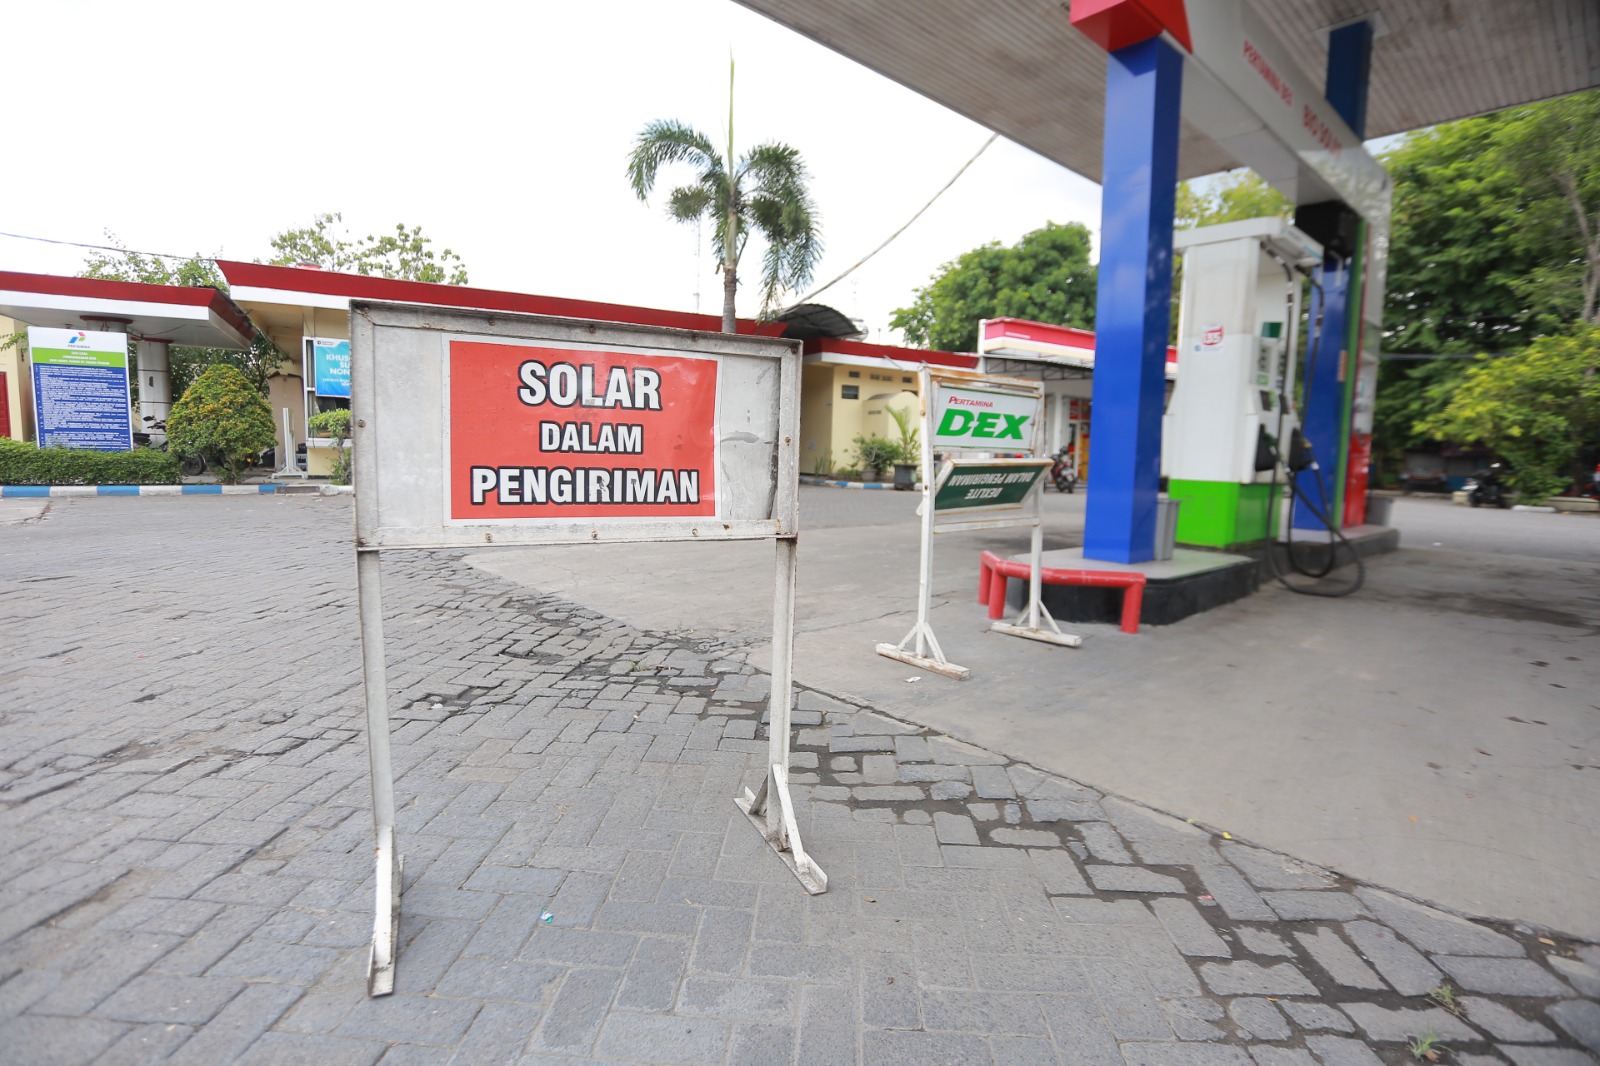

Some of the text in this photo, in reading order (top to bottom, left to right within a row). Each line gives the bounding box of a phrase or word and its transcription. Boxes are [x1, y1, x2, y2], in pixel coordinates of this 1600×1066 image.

[326, 353, 350, 362] KHUS
[518, 360, 662, 410] SOLAR
[949, 396, 994, 408] PERTAMINA
[936, 408, 1031, 440] DEX
[539, 420, 643, 455] DALAM
[470, 466, 700, 506] PENGIRIMAN
[947, 471, 1036, 487] DALAM PENGIRIMAN
[964, 487, 1004, 500] DEXLITE
